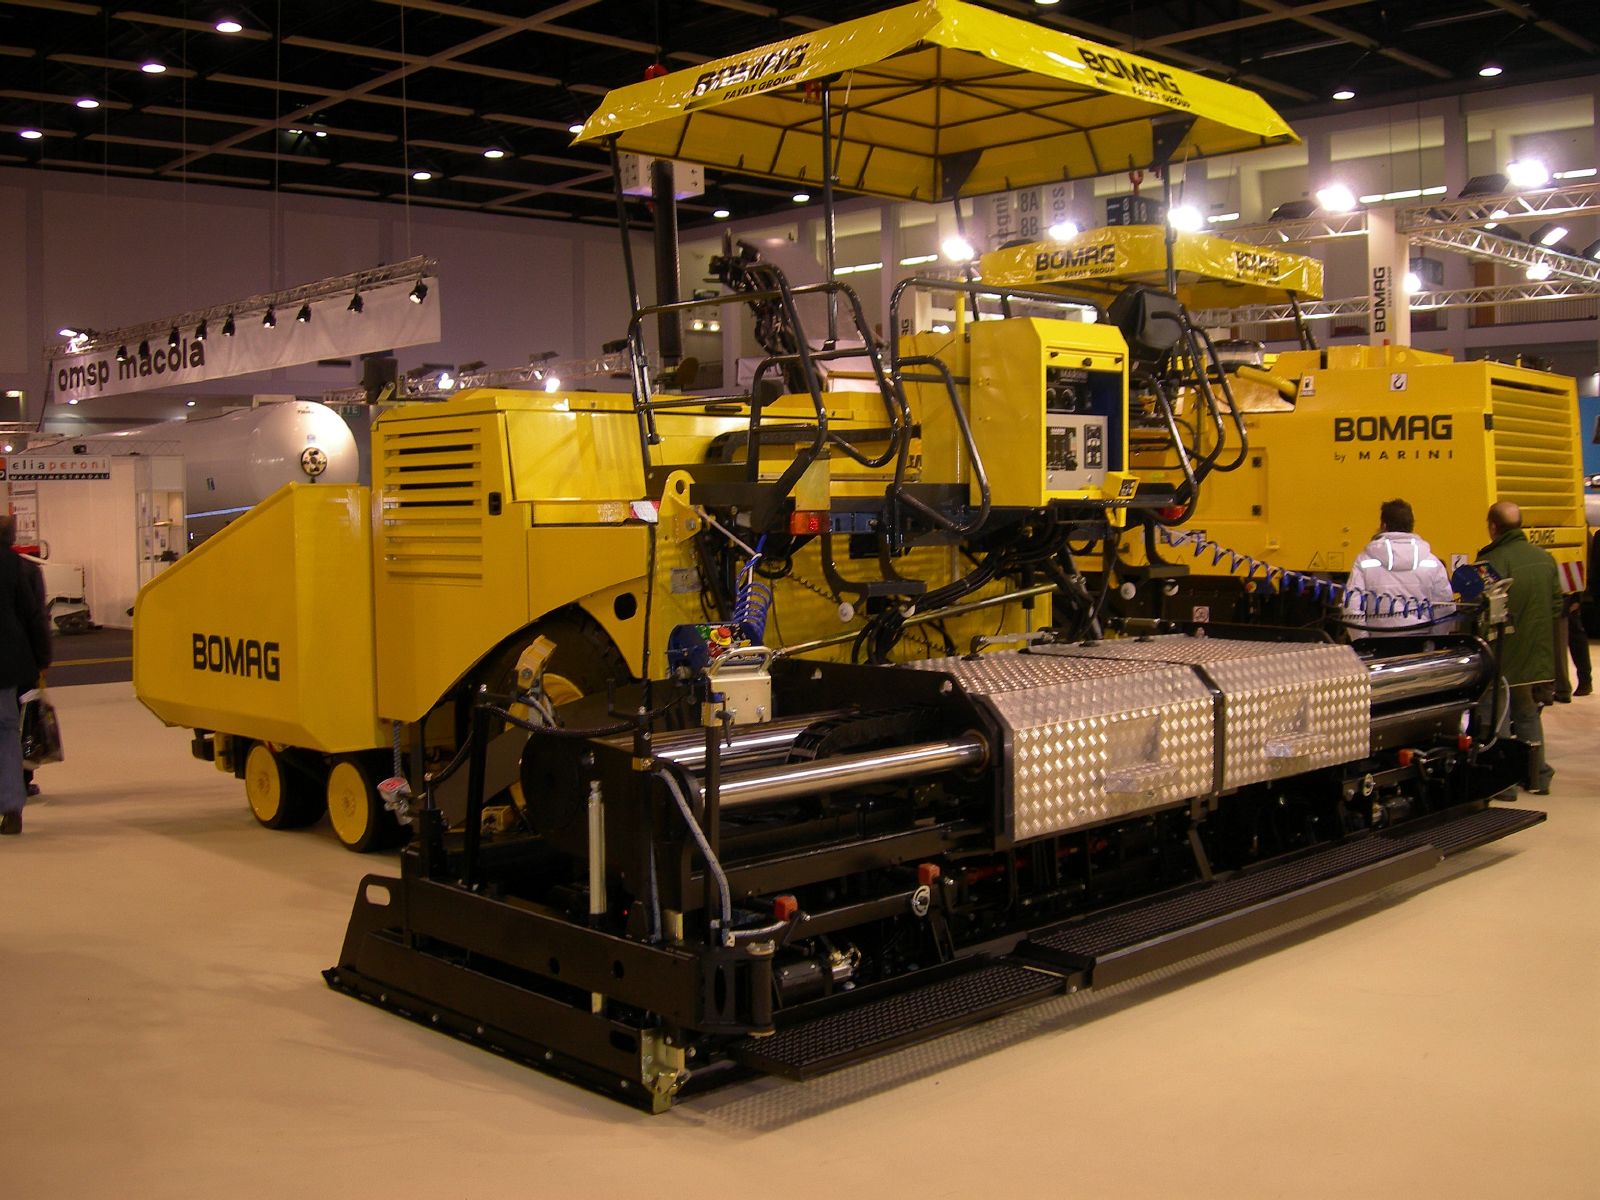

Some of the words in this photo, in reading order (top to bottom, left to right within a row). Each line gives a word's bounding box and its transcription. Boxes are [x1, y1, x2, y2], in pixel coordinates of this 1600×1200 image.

[1078, 47, 1183, 96] BOMAG
[723, 84, 756, 101] FAYAT
[758, 73, 797, 91] GROUP
[1020, 191, 1039, 213] 8A
[1020, 216, 1039, 237] 8B
[1035, 244, 1115, 272] BOMAG
[1373, 266, 1386, 333] BOMAG
[58, 358, 110, 392] omsp
[118, 337, 205, 381] macola
[1334, 415, 1453, 442] BOMAG
[1334, 451, 1346, 463] by
[1359, 449, 1453, 461] MARINI
[1529, 529, 1556, 544] BOMAG
[192, 632, 280, 682] BOMAG
